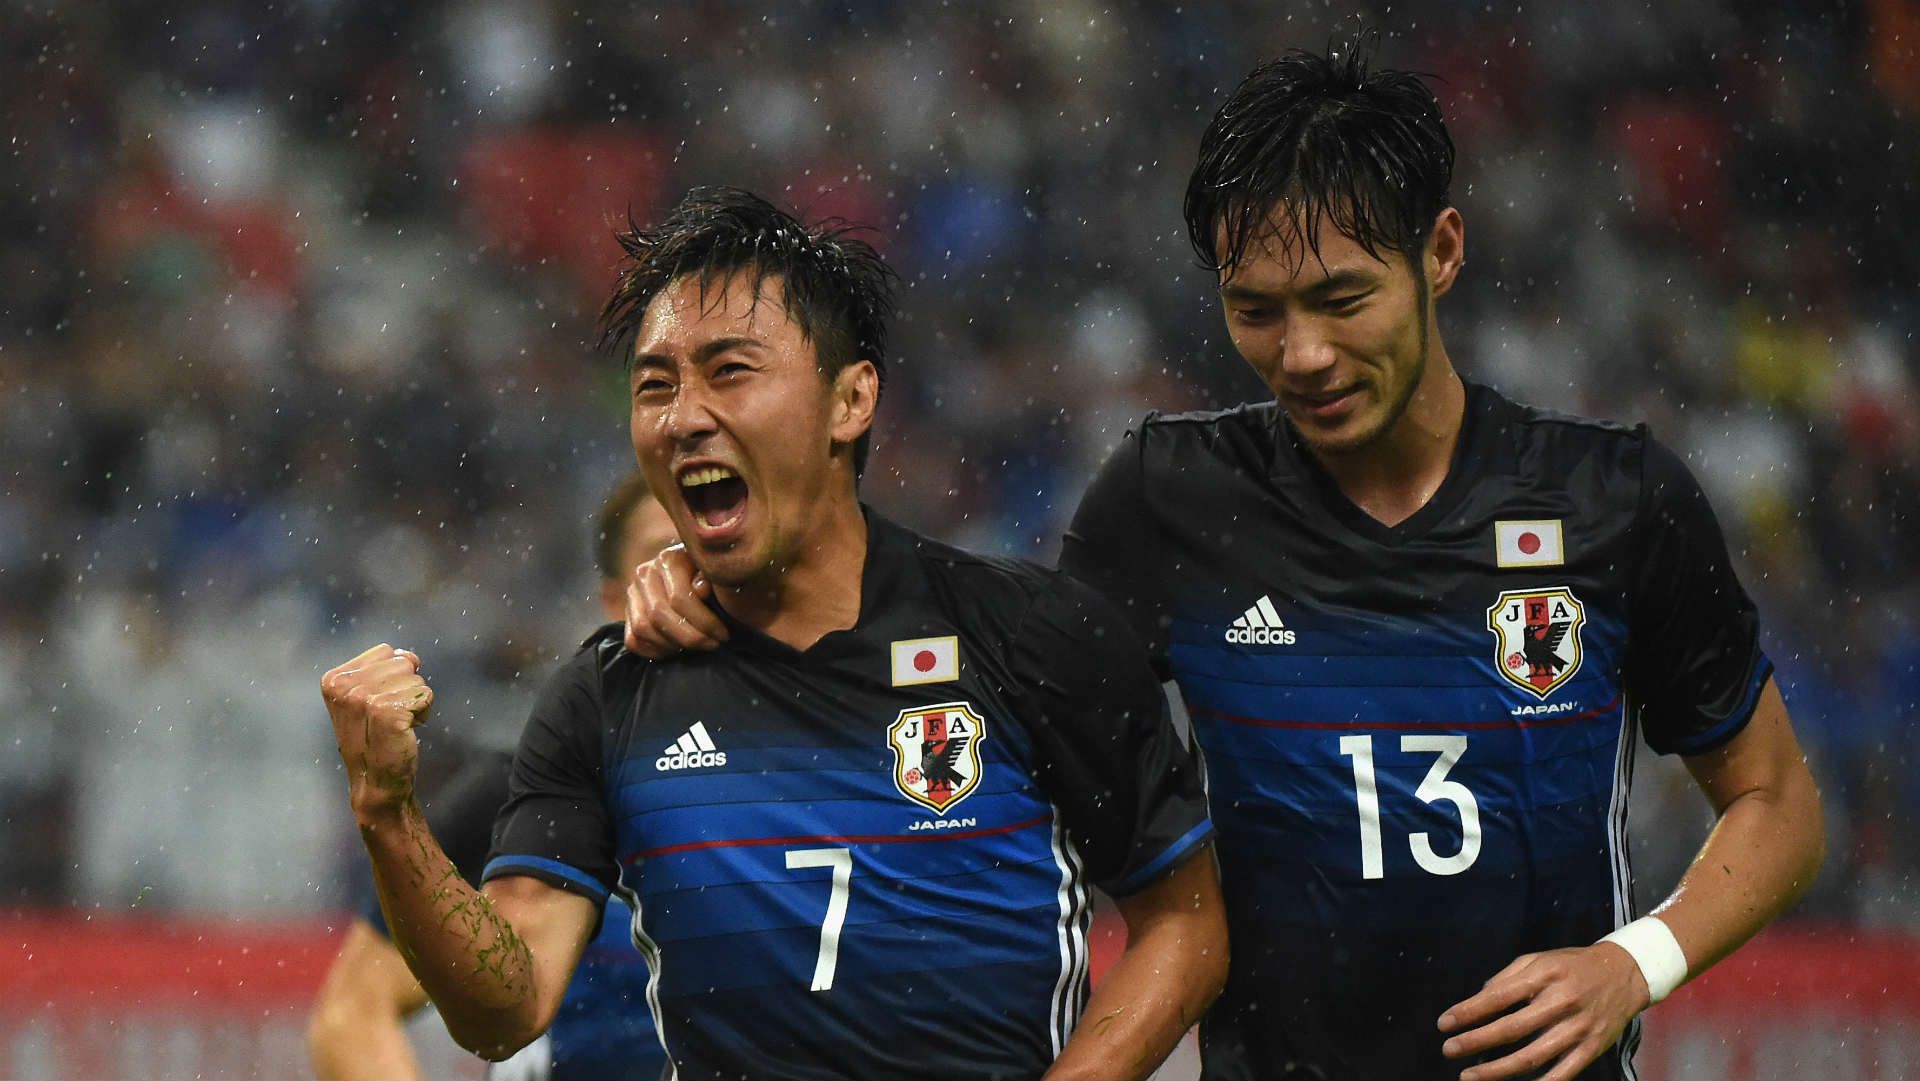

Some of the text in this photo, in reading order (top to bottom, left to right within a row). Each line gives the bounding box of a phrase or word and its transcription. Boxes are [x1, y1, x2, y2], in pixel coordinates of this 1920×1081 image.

[1505, 600, 1571, 623] JFA
[1225, 625, 1296, 645] adidas
[1511, 703, 1573, 716] JAPAN
[904, 717, 968, 740] JFA
[656, 750, 727, 772] adidas
[1339, 735, 1482, 880] 13
[908, 817, 976, 831] JAPAN
[785, 848, 852, 991] 7
